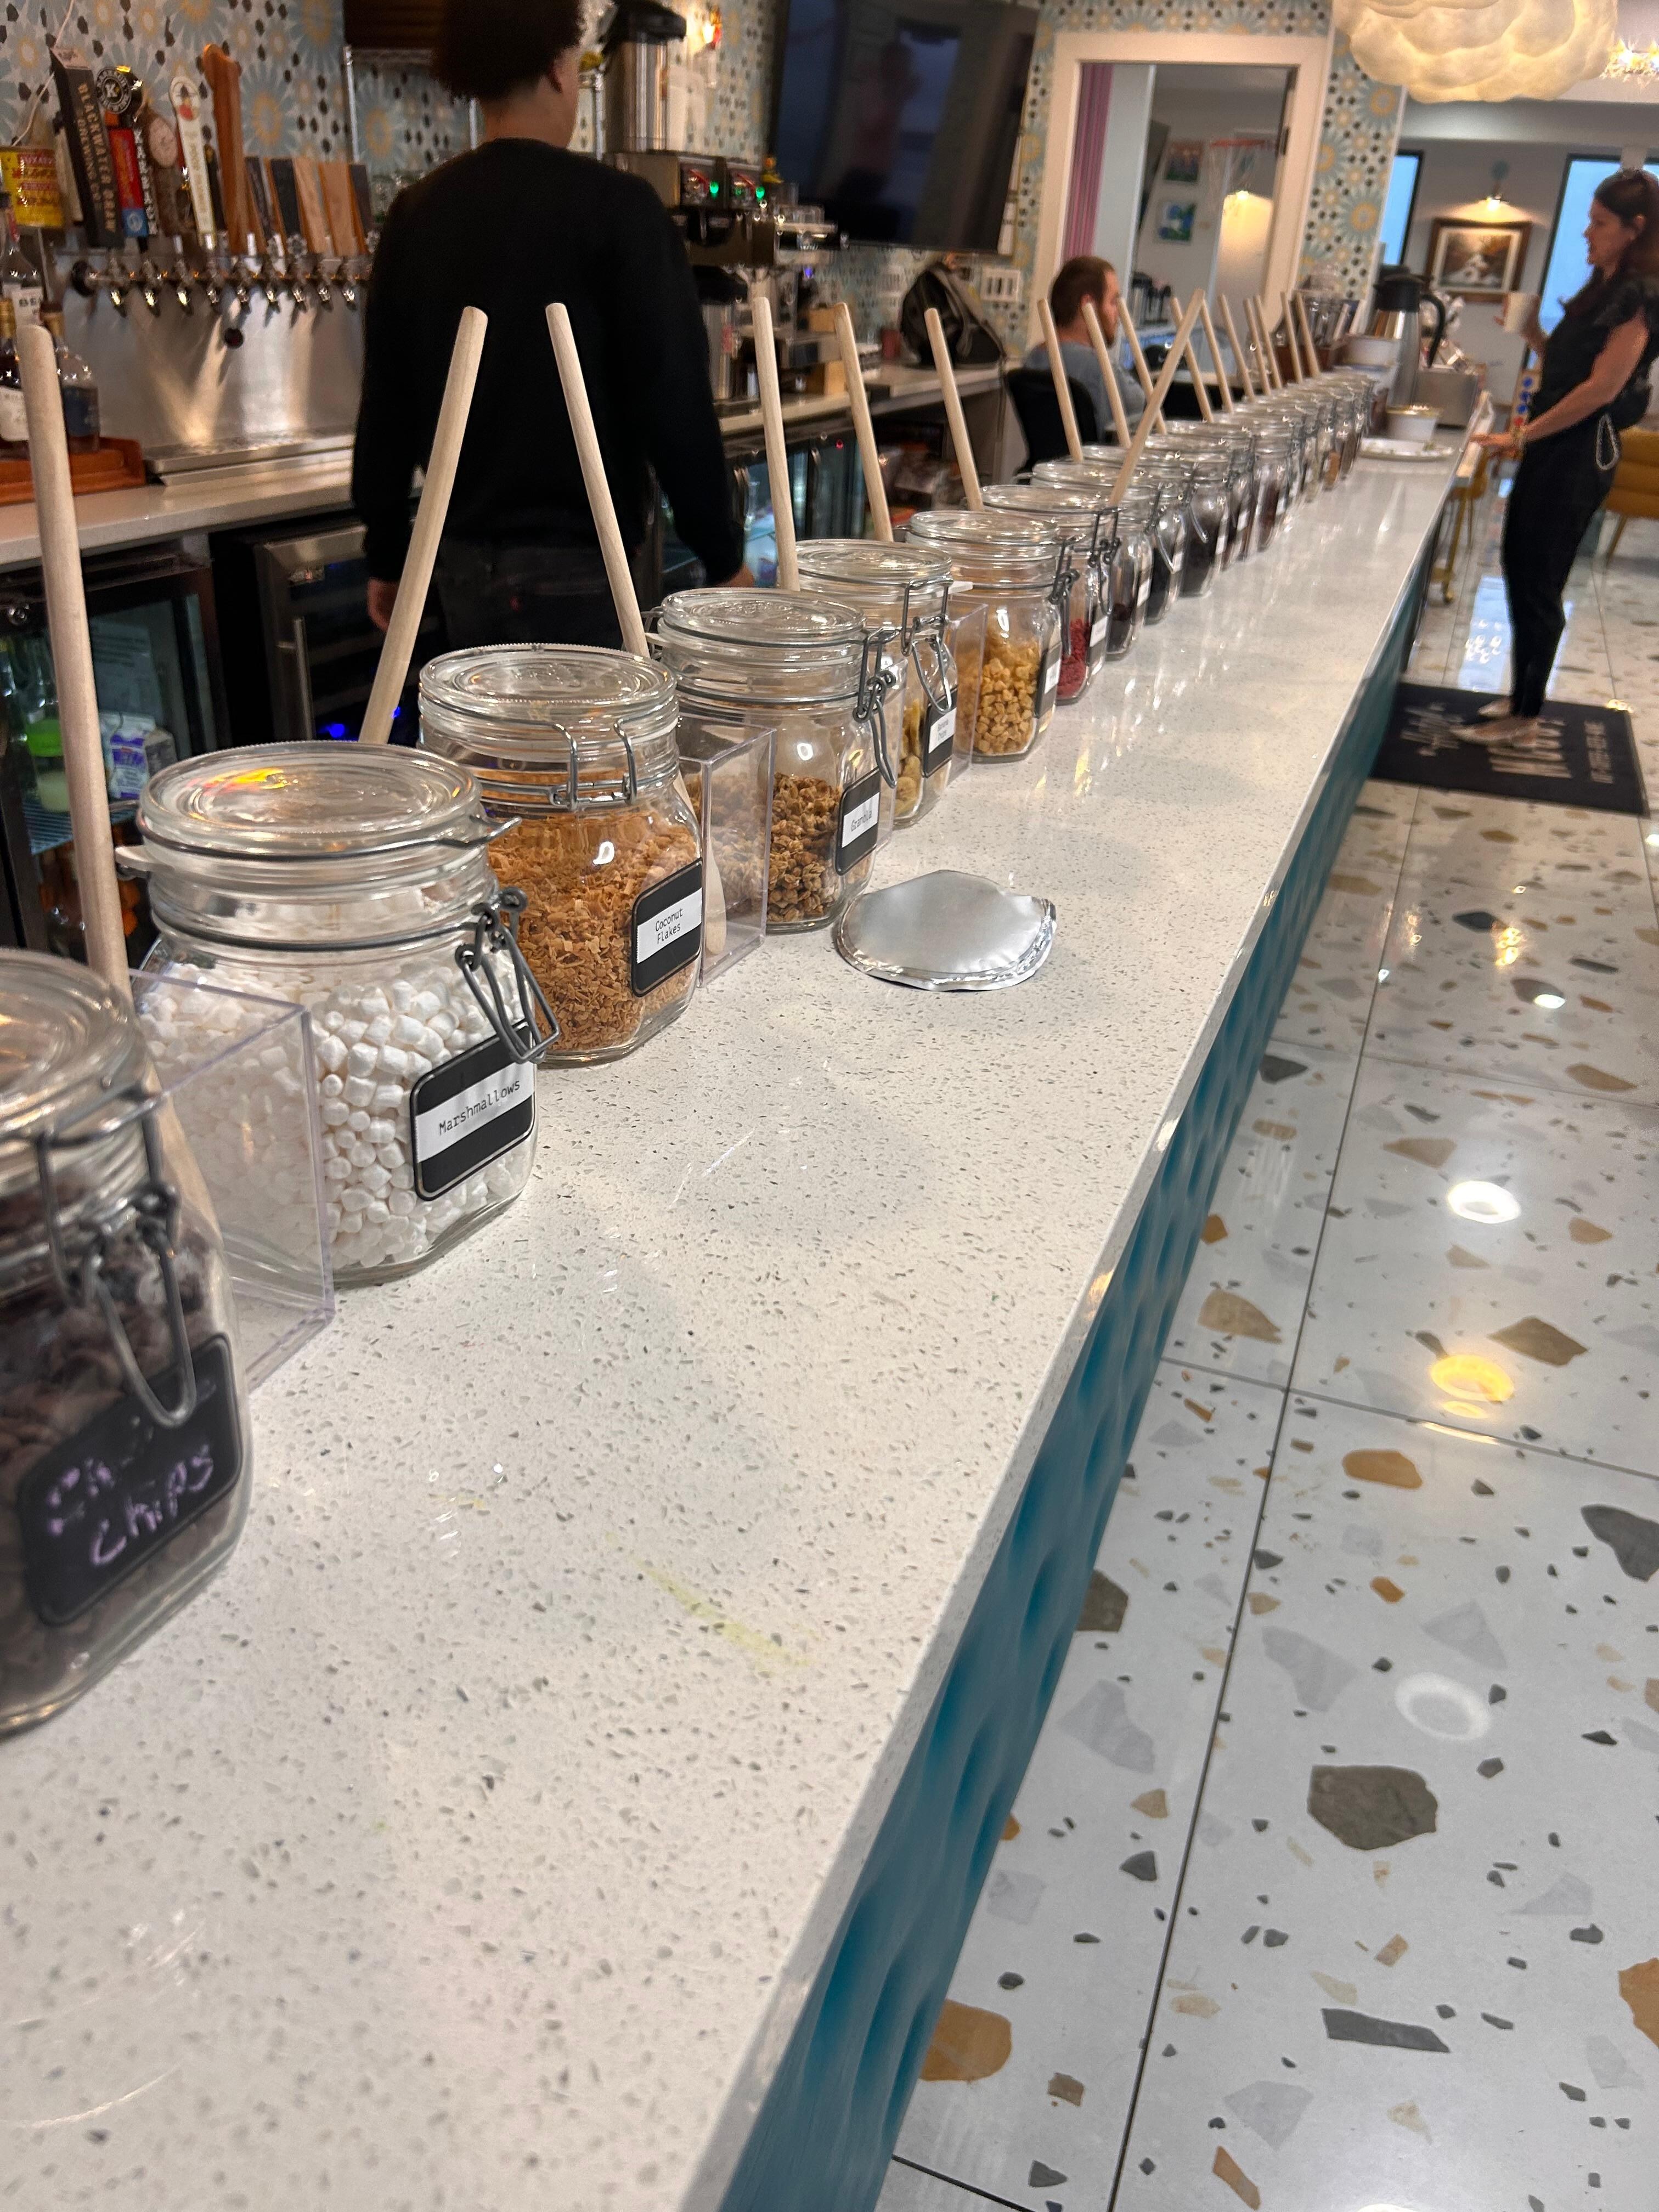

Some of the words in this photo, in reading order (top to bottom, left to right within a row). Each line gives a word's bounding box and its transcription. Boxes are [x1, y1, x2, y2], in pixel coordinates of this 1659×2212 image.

[78, 82, 112, 184] BLACKWATER
[850, 810, 873, 832] Granola
[655, 907, 684, 932] Coconut
[657, 923, 681, 944] Flakes
[438, 1079, 521, 1137] Marshmallows
